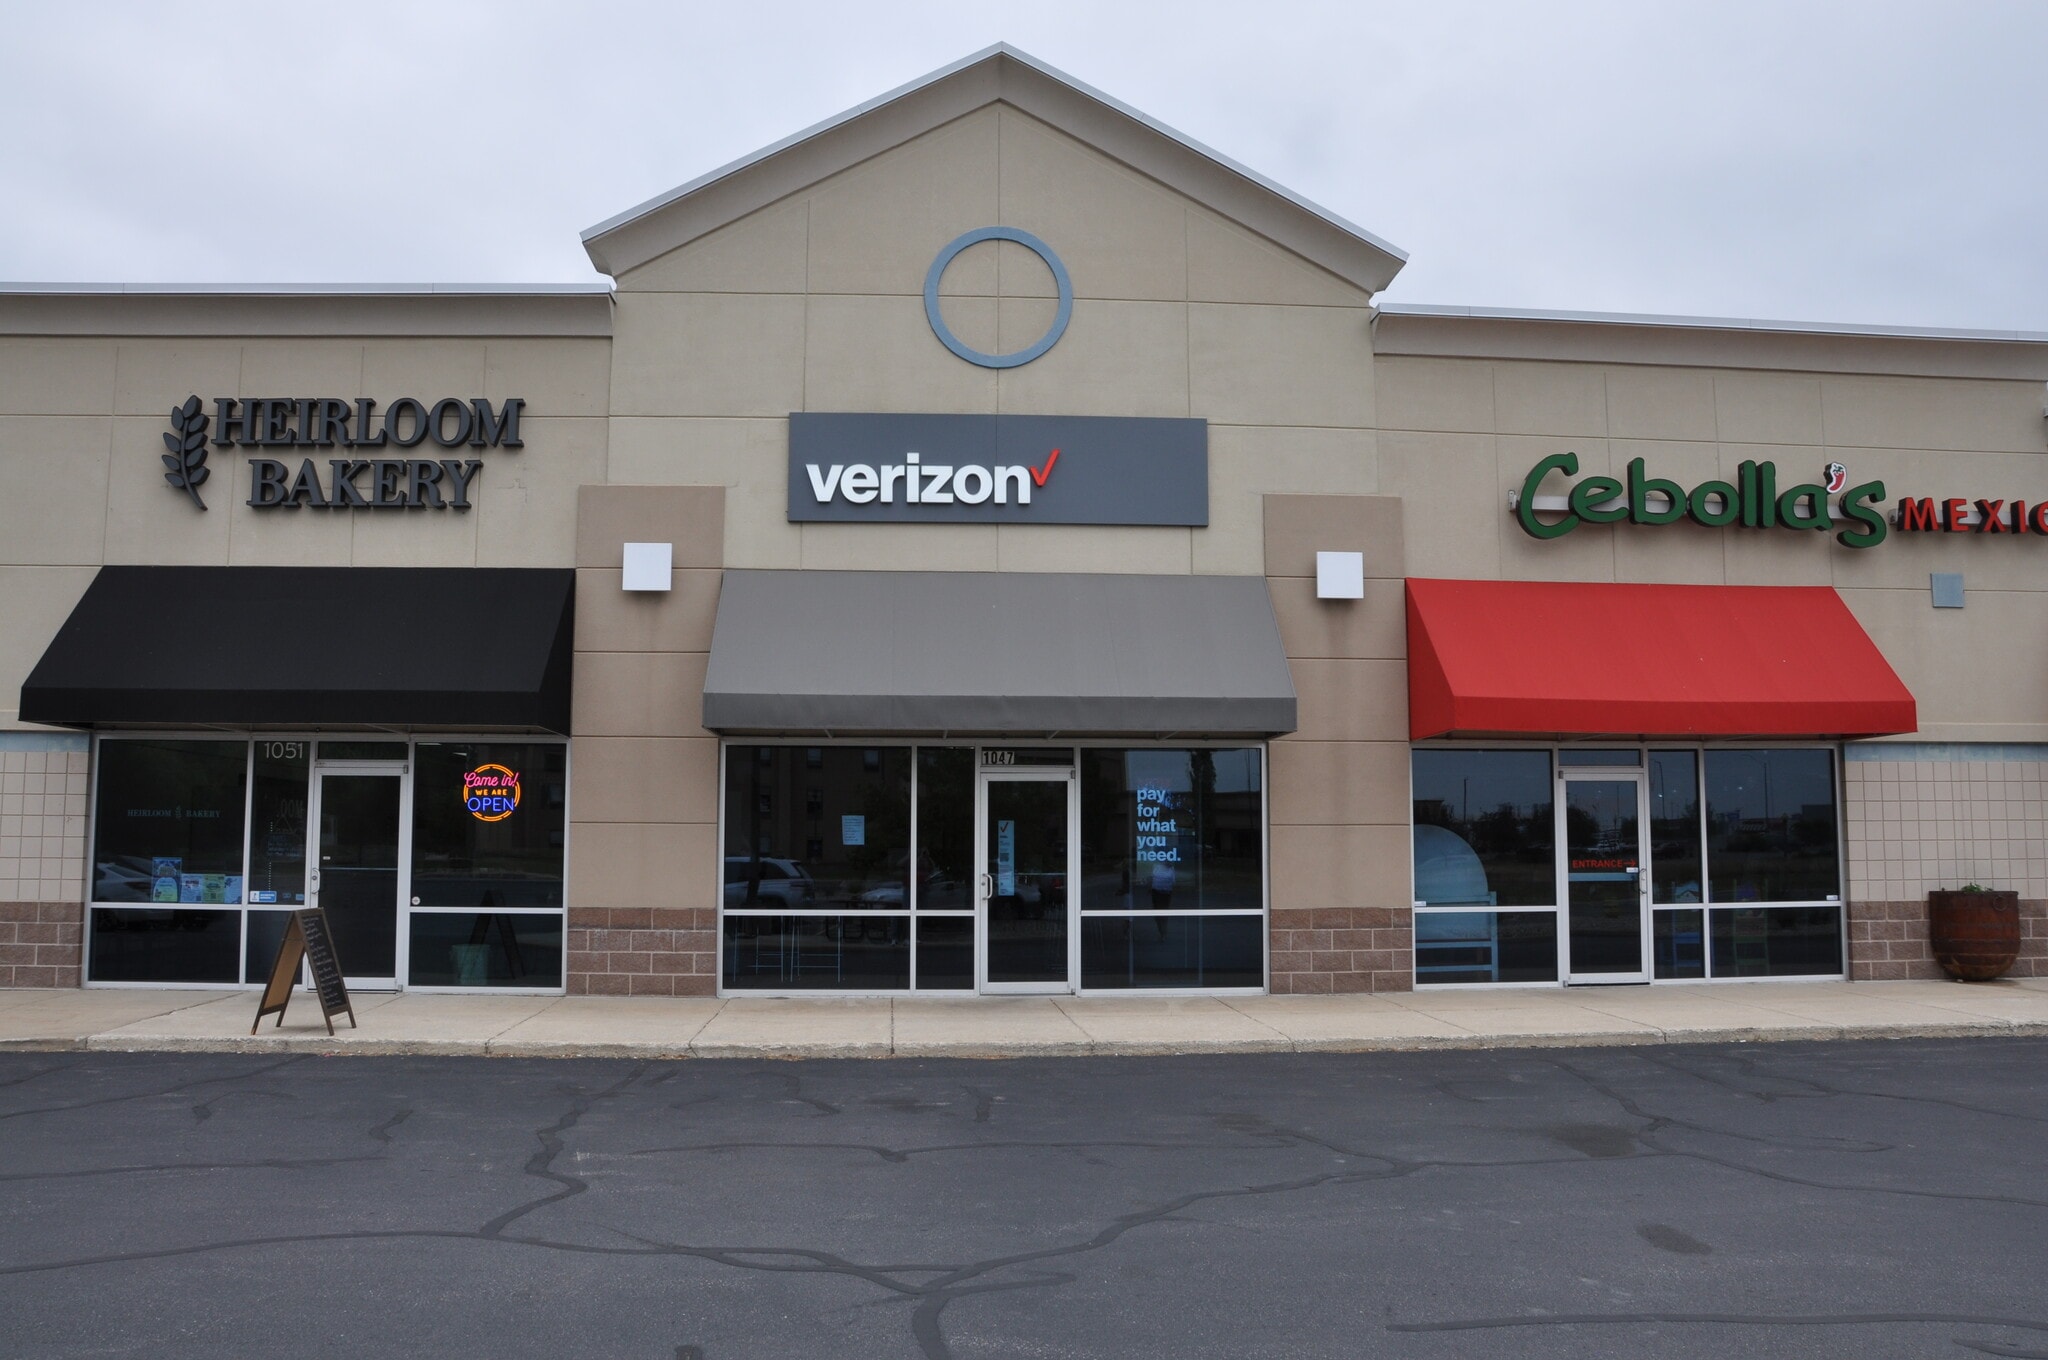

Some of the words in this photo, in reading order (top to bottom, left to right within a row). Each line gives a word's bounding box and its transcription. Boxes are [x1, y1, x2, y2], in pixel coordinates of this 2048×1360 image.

[211, 397, 526, 448] HEIRLOOM
[246, 458, 484, 509] BAKERY
[805, 452, 1031, 504] verizon
[1516, 452, 1887, 549] Cebolla's
[264, 742, 303, 759] 1051
[983, 751, 1014, 765] 1047
[464, 772, 499, 788] Come
[501, 772, 519, 788] in!
[1136, 789, 1166, 803] pay
[467, 797, 514, 811] OPEN
[1136, 803, 1160, 818] for
[127, 808, 172, 817] HEIRLOOM
[185, 809, 221, 818] BAKERY
[1136, 818, 1177, 832] what
[1136, 835, 1167, 849] you
[1136, 847, 1182, 862] need.
[1572, 859, 1623, 869] ENTRANCE
